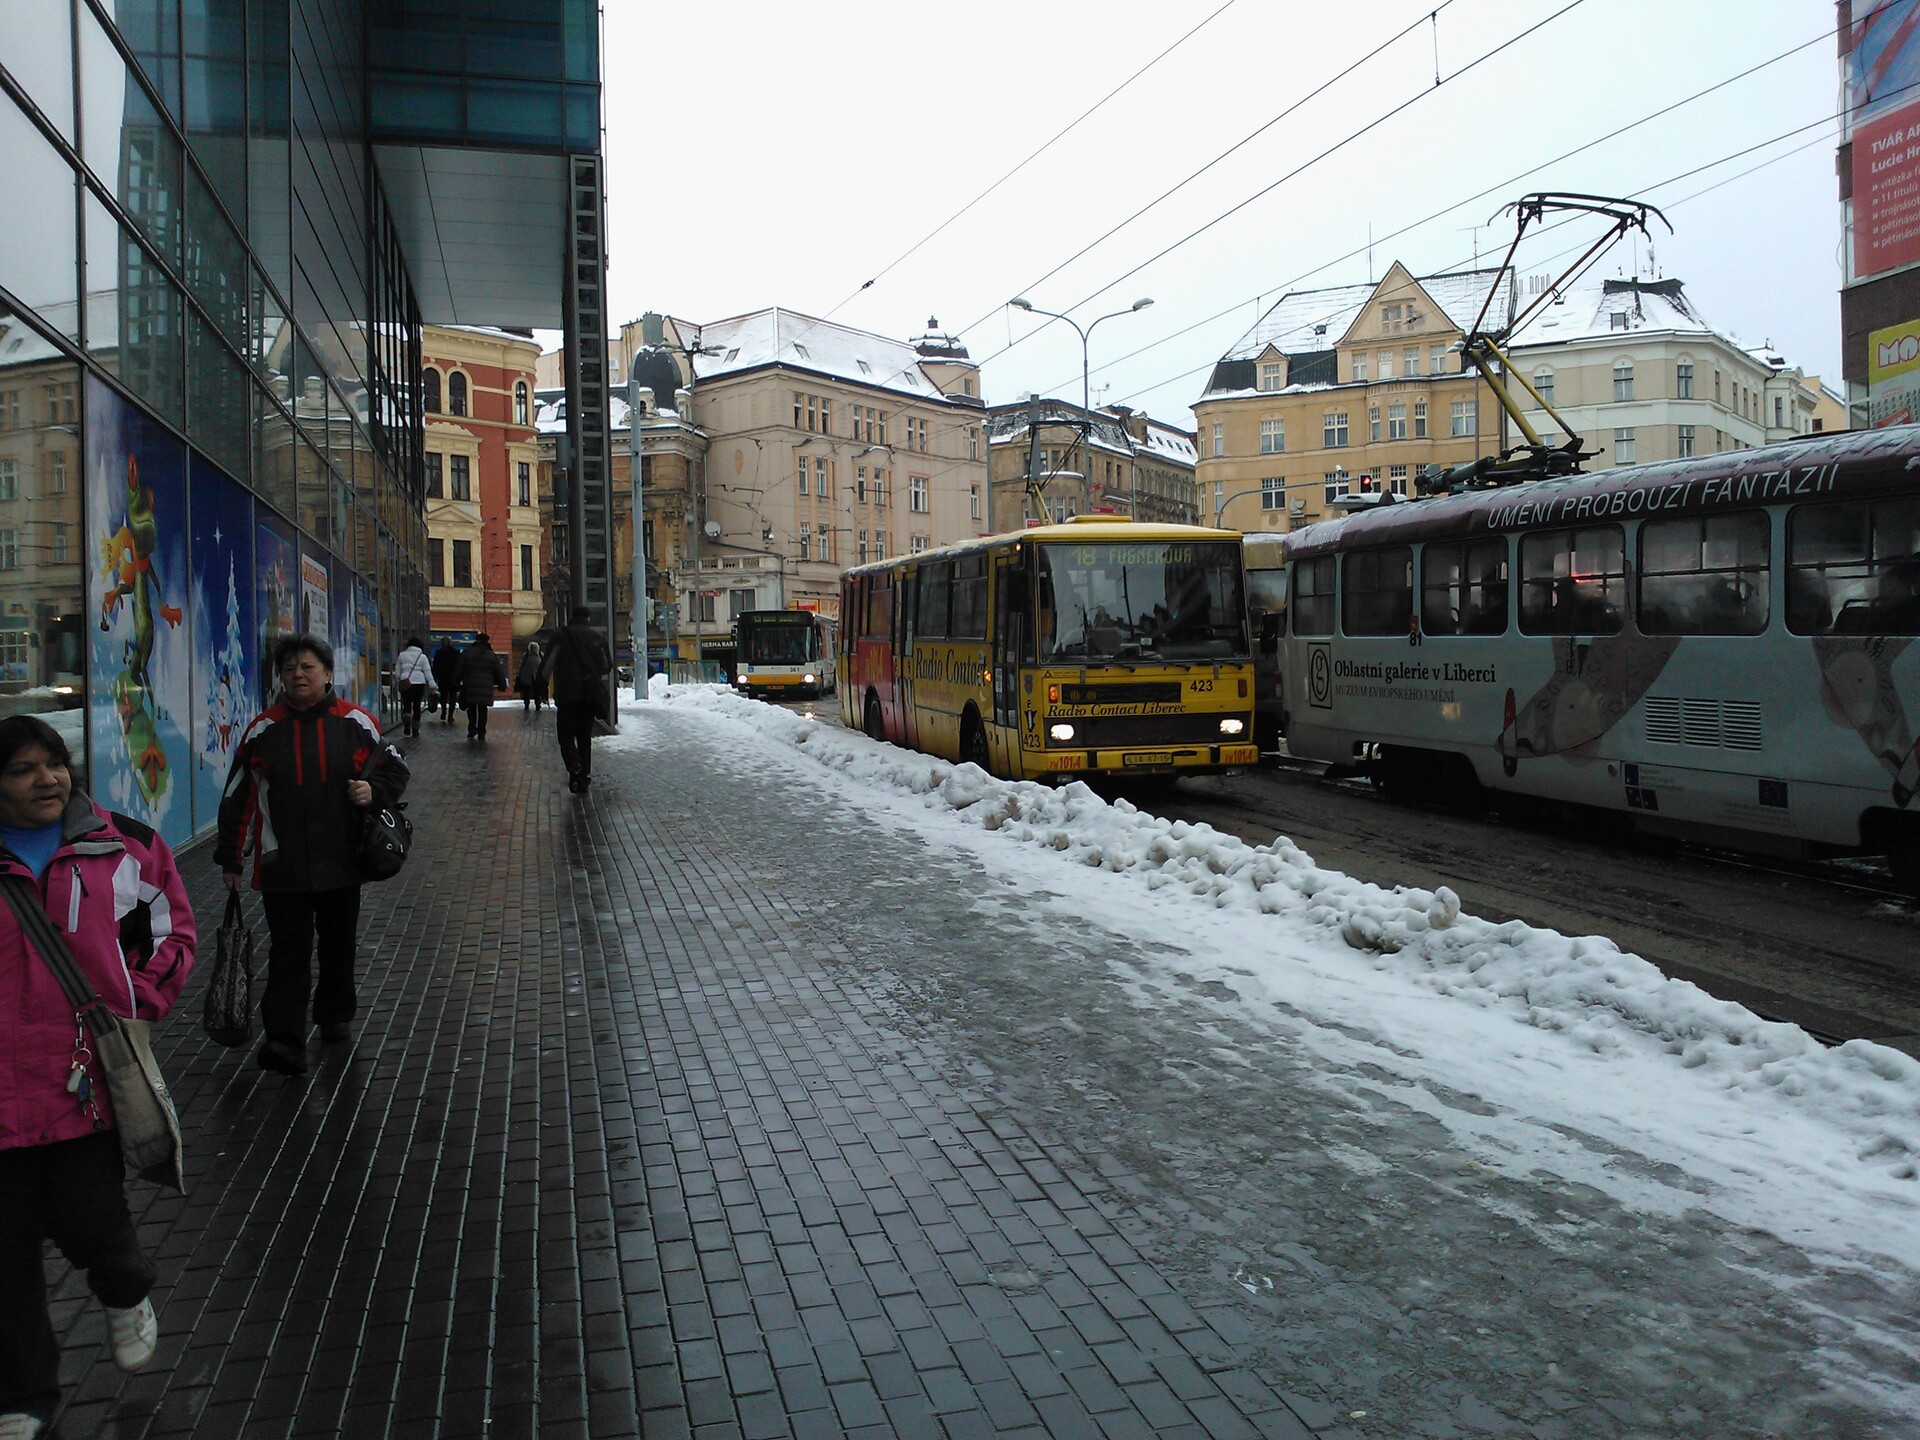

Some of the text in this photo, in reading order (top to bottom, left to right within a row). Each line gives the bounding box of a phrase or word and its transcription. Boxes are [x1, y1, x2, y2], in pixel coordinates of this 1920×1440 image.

[1871, 130, 1903, 154] TVÁŘ
[1872, 153, 1903, 173] Lucie
[1487, 463, 1841, 528] UMĚNÍ PROBOUZÍ FANTAZII
[1410, 632, 1422, 647] 81
[915, 648, 987, 687] Radio Contact
[1334, 660, 1497, 684] Oblastní galerie v Liberci
[1190, 680, 1213, 692] 423
[1335, 684, 1368, 698] MUZEUM
[1368, 684, 1423, 701] EVROPSKÉHO
[1048, 702, 1186, 717] Radio Contact Liberec
[1024, 733, 1041, 748] 423
